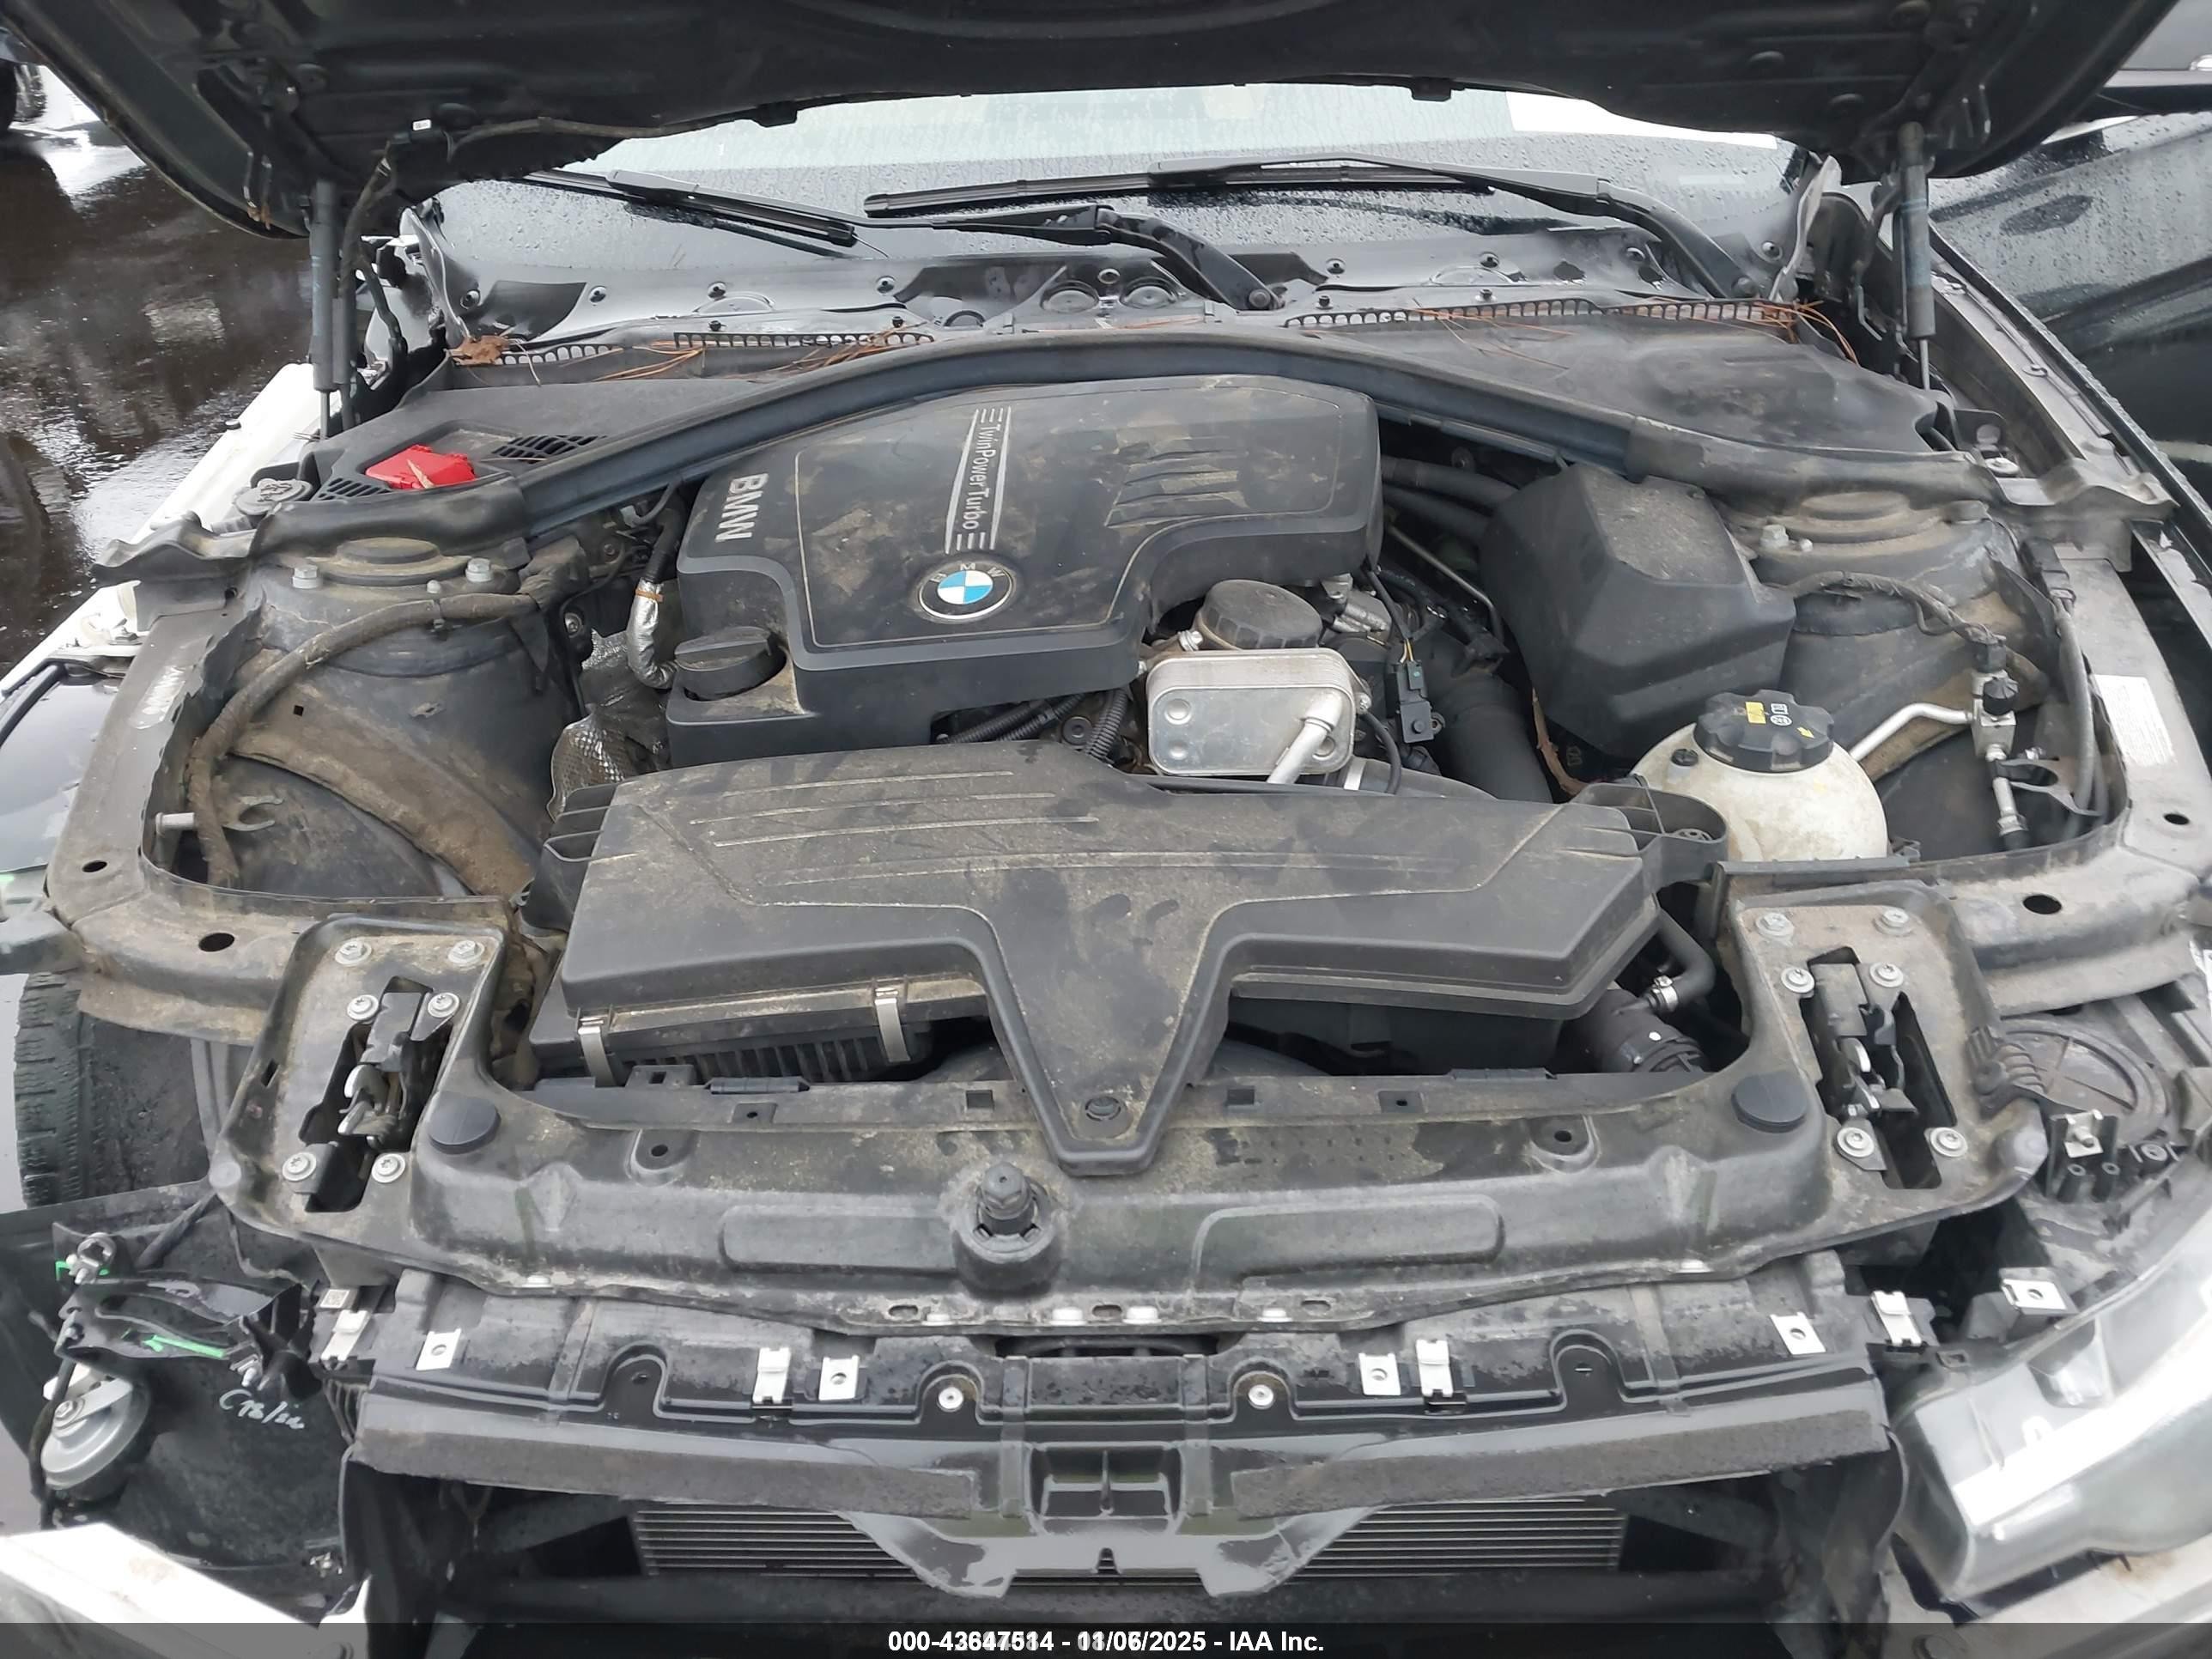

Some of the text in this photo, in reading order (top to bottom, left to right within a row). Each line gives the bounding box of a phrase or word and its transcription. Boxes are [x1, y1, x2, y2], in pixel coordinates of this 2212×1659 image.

[714, 473, 769, 543] BMW
[963, 424, 1001, 530] TwinPower Turbo
